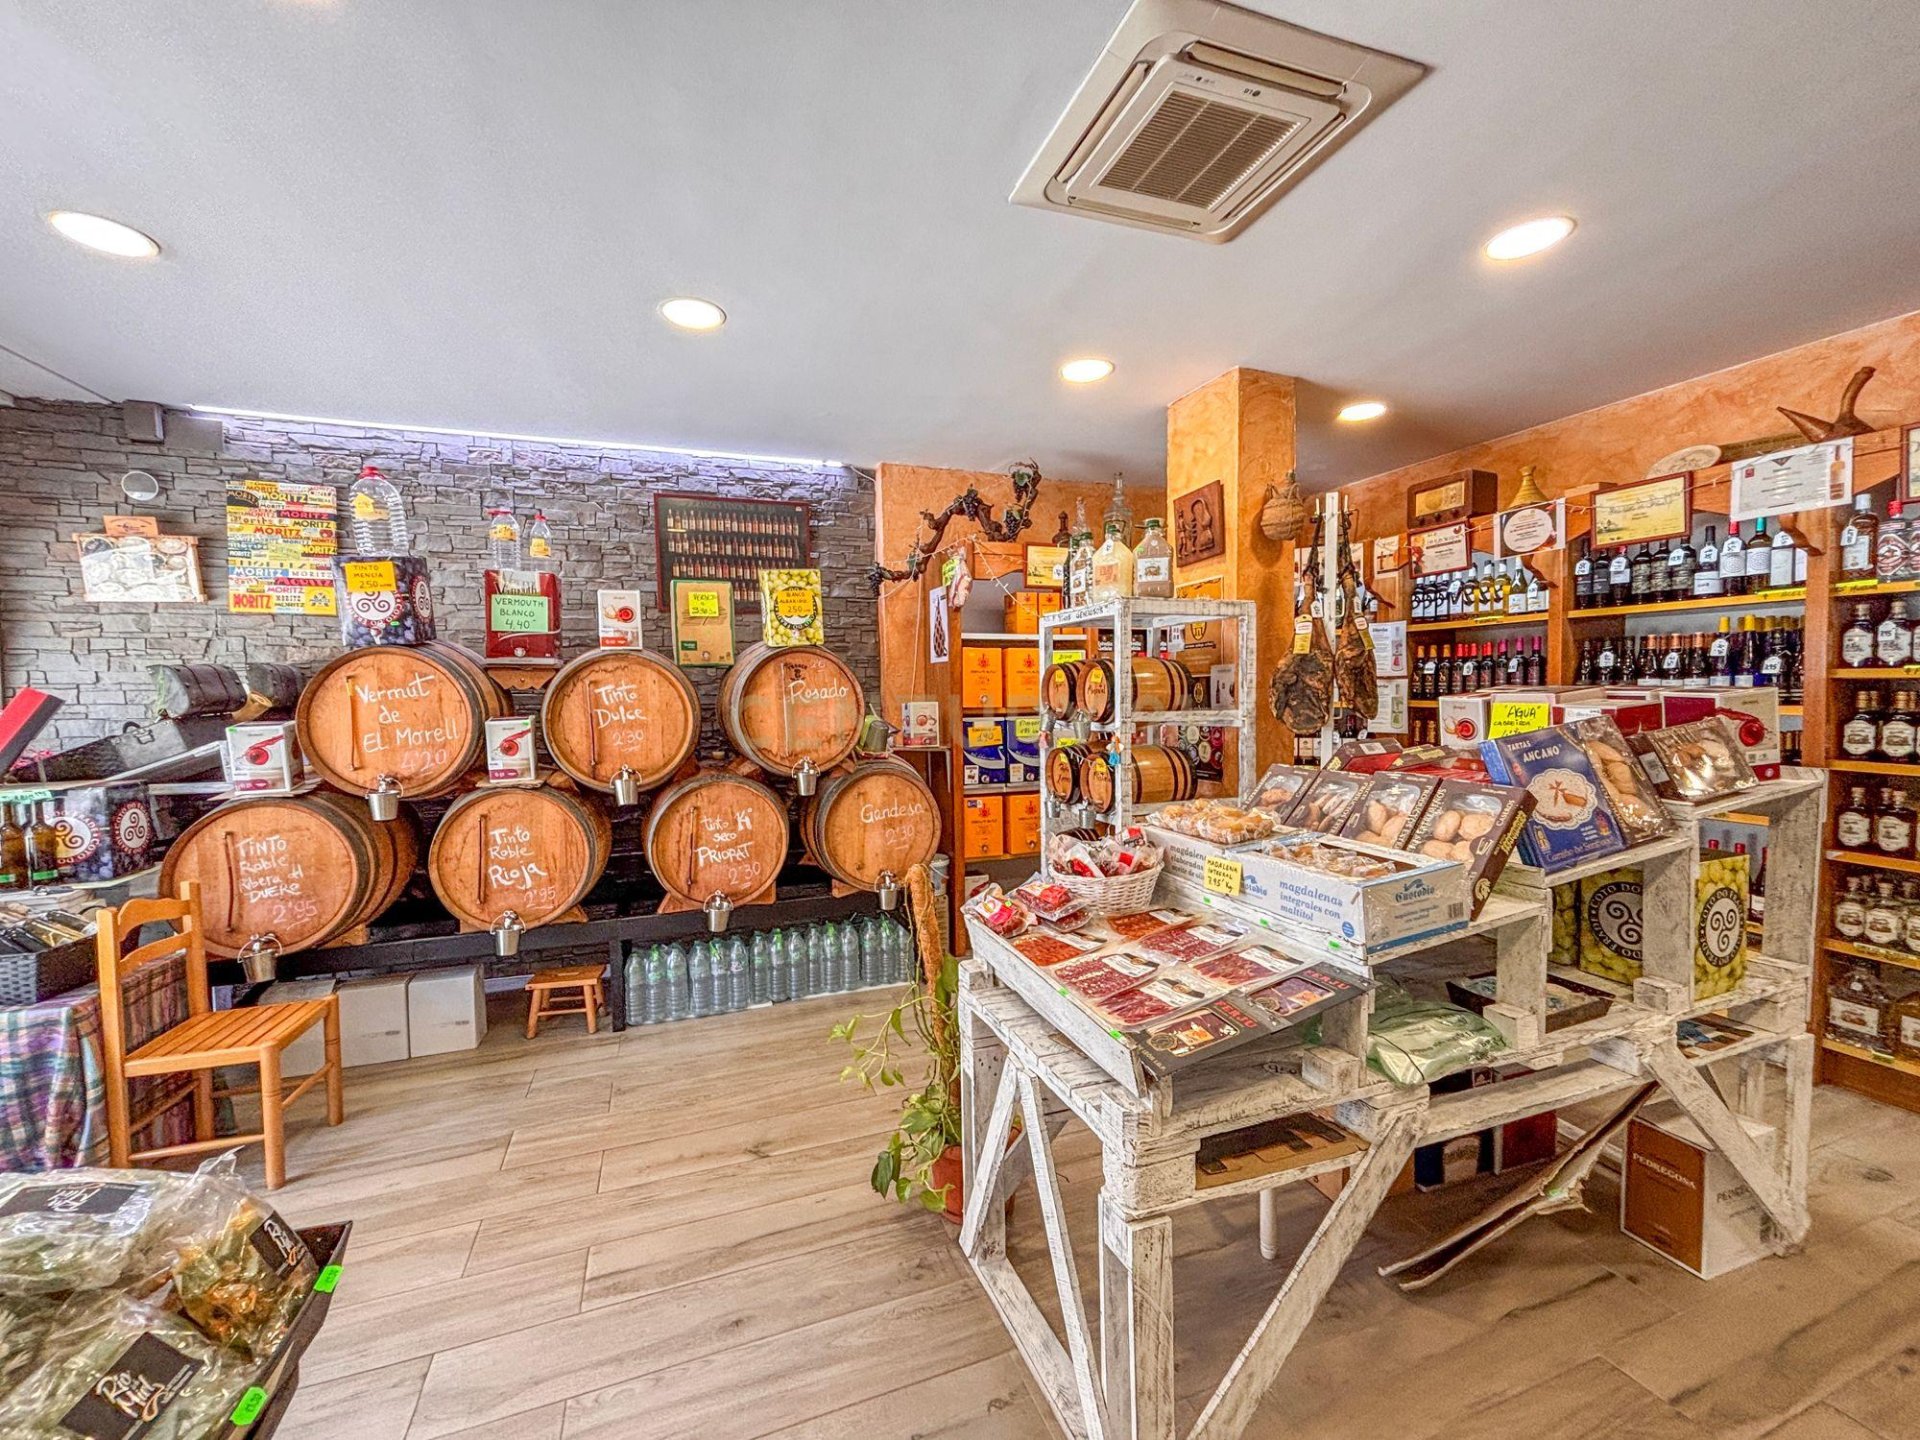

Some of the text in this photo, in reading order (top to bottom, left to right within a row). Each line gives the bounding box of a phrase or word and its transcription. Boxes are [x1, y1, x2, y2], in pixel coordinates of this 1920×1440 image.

[280, 511, 329, 519] MORITZ
[293, 520, 331, 528] MORITZ
[254, 526, 301, 537] MORITZ
[233, 568, 284, 577] MORITZ
[233, 594, 271, 609] MORITZ
[495, 597, 544, 607] VERMOUTH
[500, 608, 535, 617] BLANCO
[355, 673, 435, 703] Vermut
[594, 683, 638, 705] Tinto
[788, 678, 849, 704] Rosado
[378, 705, 401, 724] de
[596, 707, 647, 728] Dulce
[396, 717, 459, 746] Morell
[1507, 741, 1531, 751] TARTAS
[860, 801, 925, 824] Gandesa
[489, 825, 530, 845] Tinto
[490, 843, 535, 861] Roble
[239, 855, 288, 873] Roble
[487, 862, 548, 889] Rioja
[1280, 881, 1343, 907] magdalenas
[1590, 885, 1617, 908] COTO
[1280, 892, 1341, 919] integrales con
[1280, 905, 1314, 921] maltitol
[96, 1370, 132, 1403] Rio
